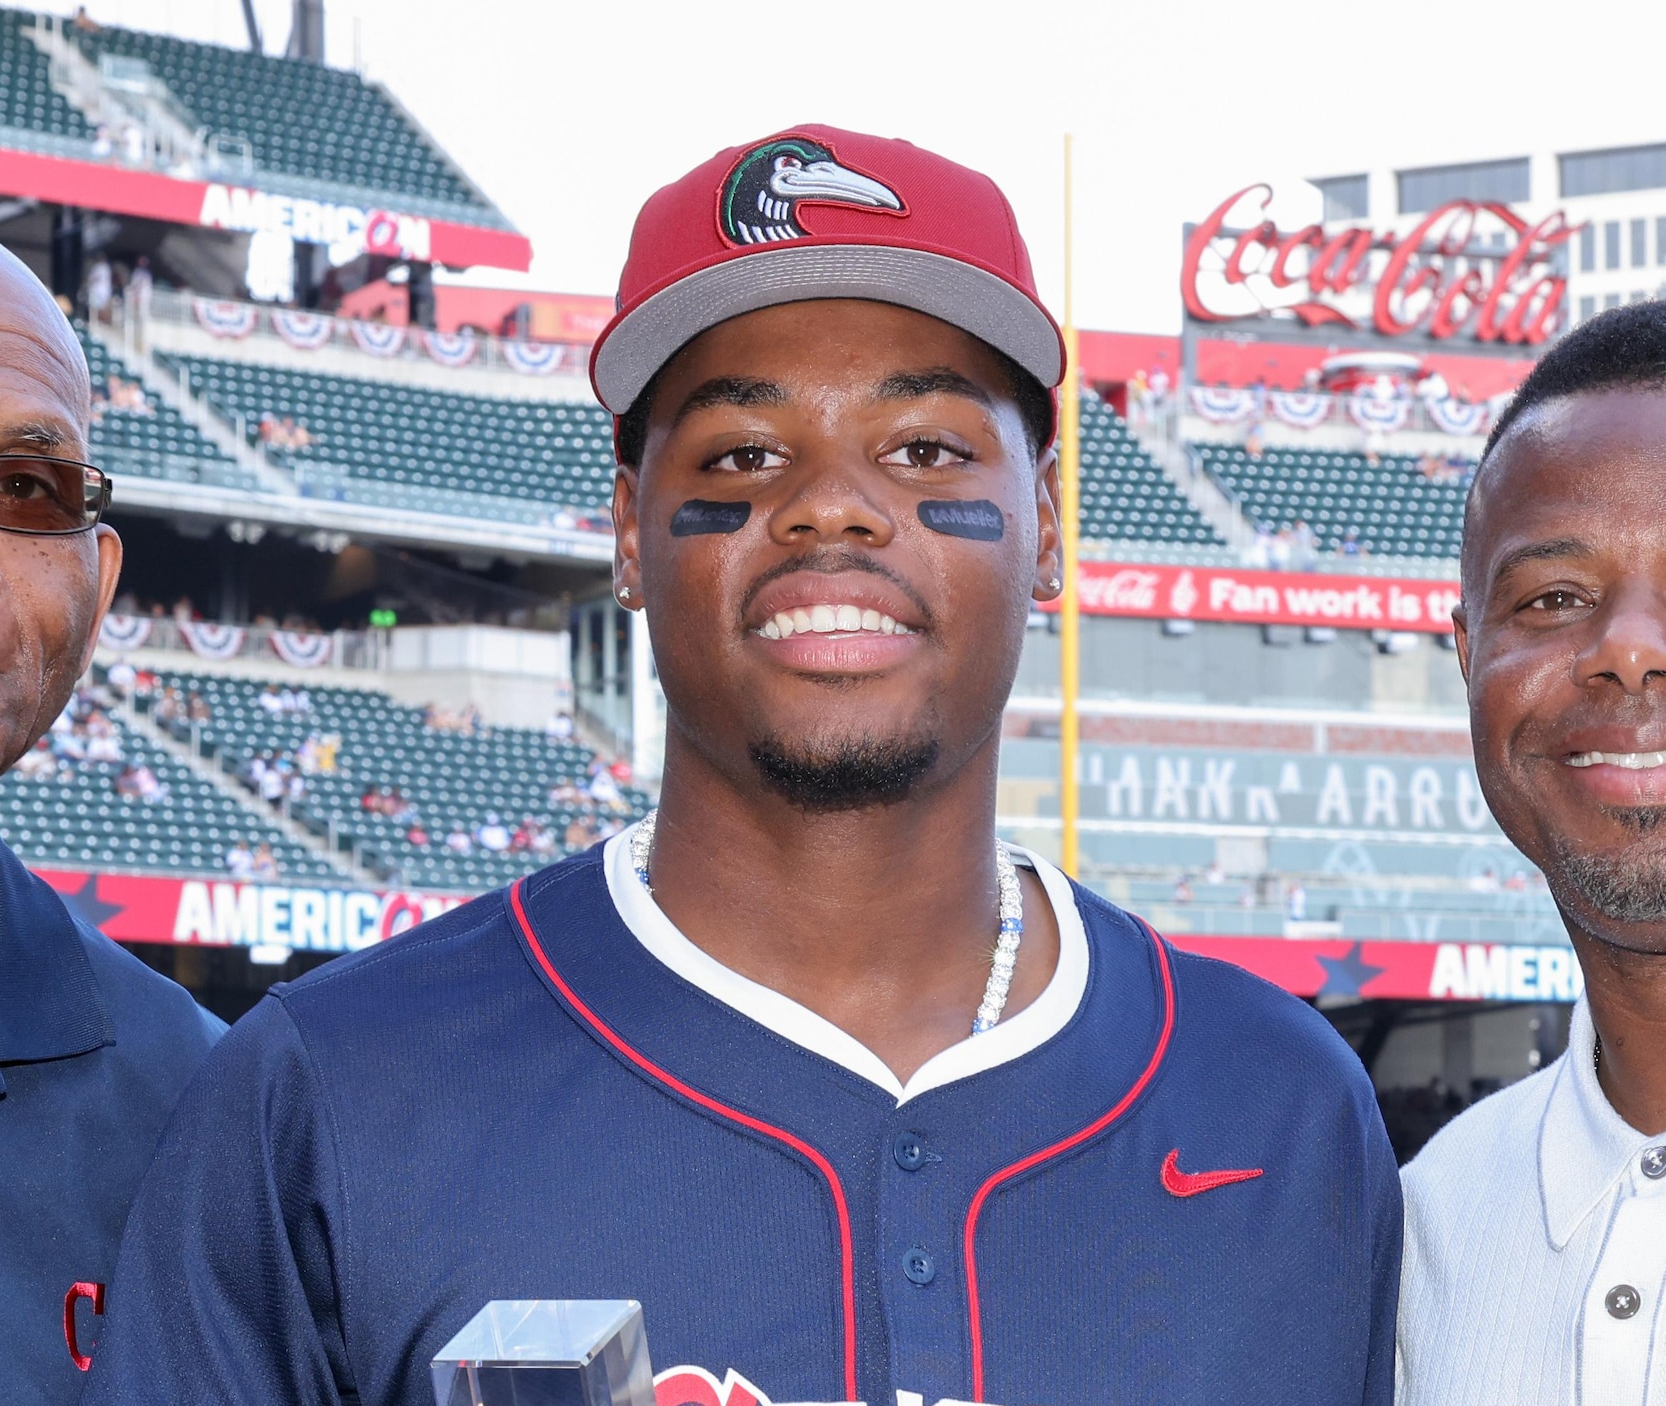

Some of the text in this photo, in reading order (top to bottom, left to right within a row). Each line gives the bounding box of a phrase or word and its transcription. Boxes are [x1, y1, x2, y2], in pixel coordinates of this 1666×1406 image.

[1180, 182, 1588, 344] Coca-Cola
[1209, 578, 1279, 614] Fan
[1285, 584, 1381, 618] work
[1389, 586, 1422, 621] is
